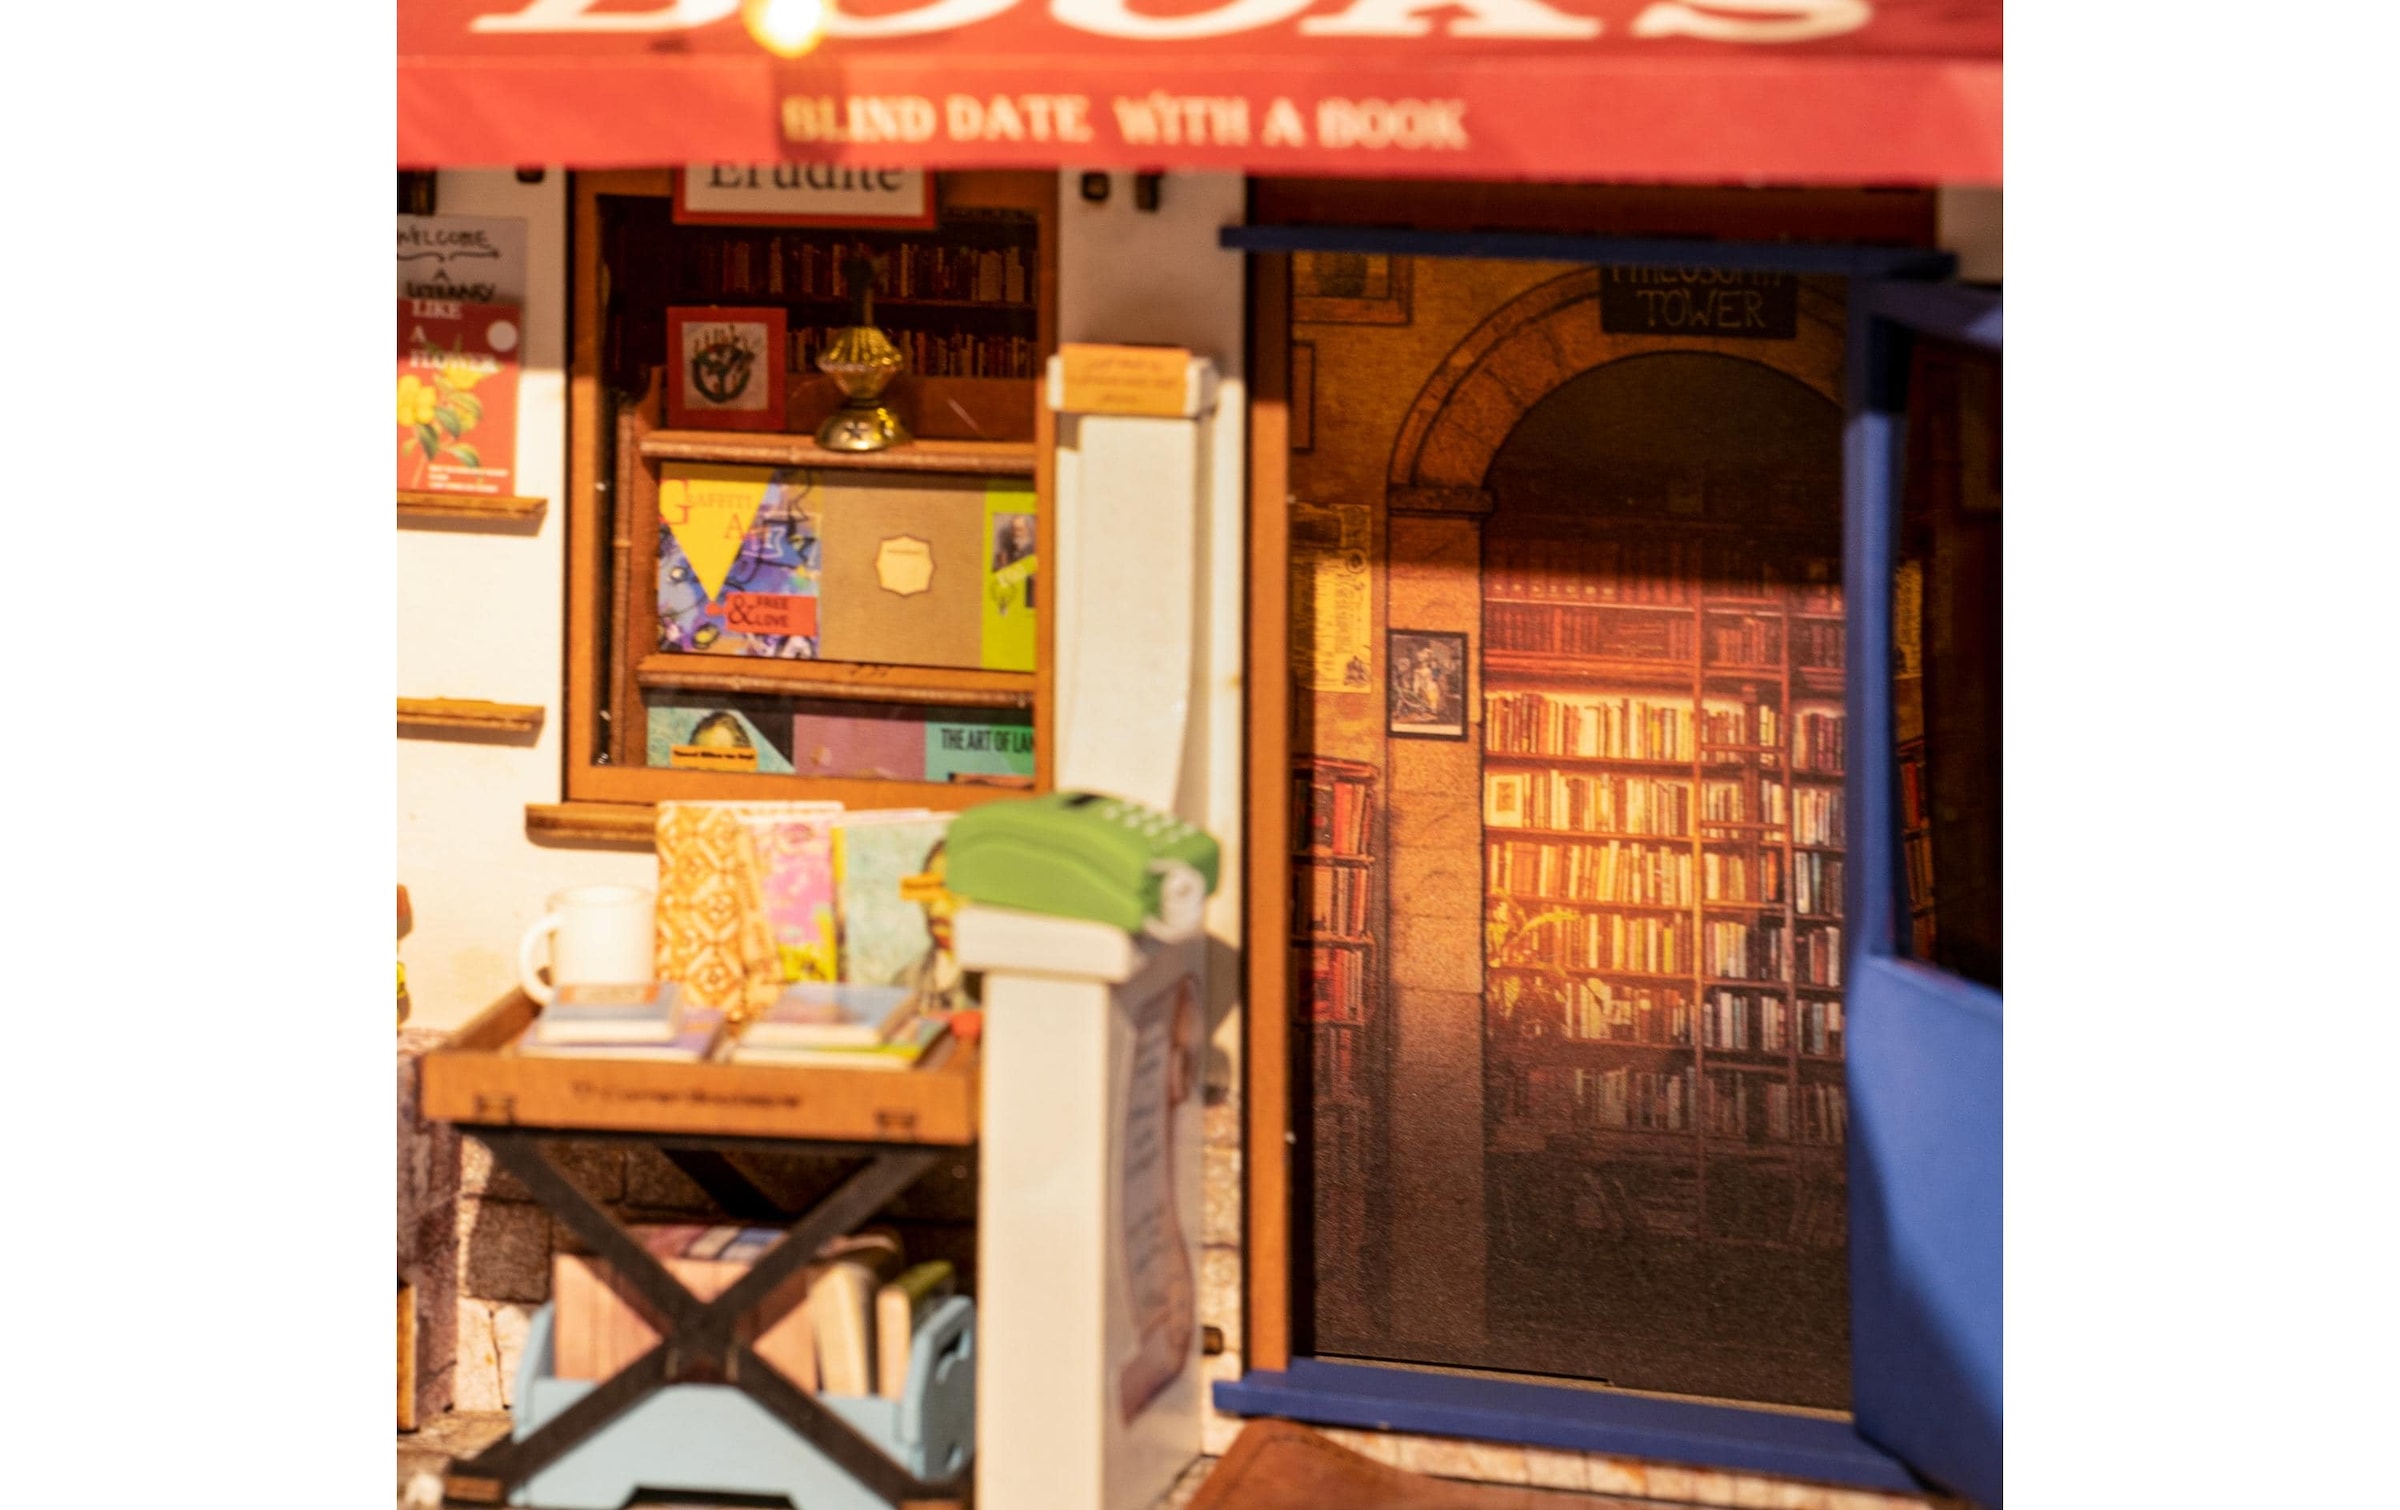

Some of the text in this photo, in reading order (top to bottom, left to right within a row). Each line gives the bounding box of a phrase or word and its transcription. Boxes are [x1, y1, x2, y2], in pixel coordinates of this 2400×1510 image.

[780, 90, 1471, 150] BLIND DATE WITH A BOOK
[707, 163, 904, 192] Erudite
[412, 300, 463, 319] LIKE
[1635, 286, 1766, 329] TOWER
[410, 324, 427, 343] A
[941, 727, 964, 752] THE
[966, 728, 991, 753] ART
[993, 730, 1011, 755] OF
